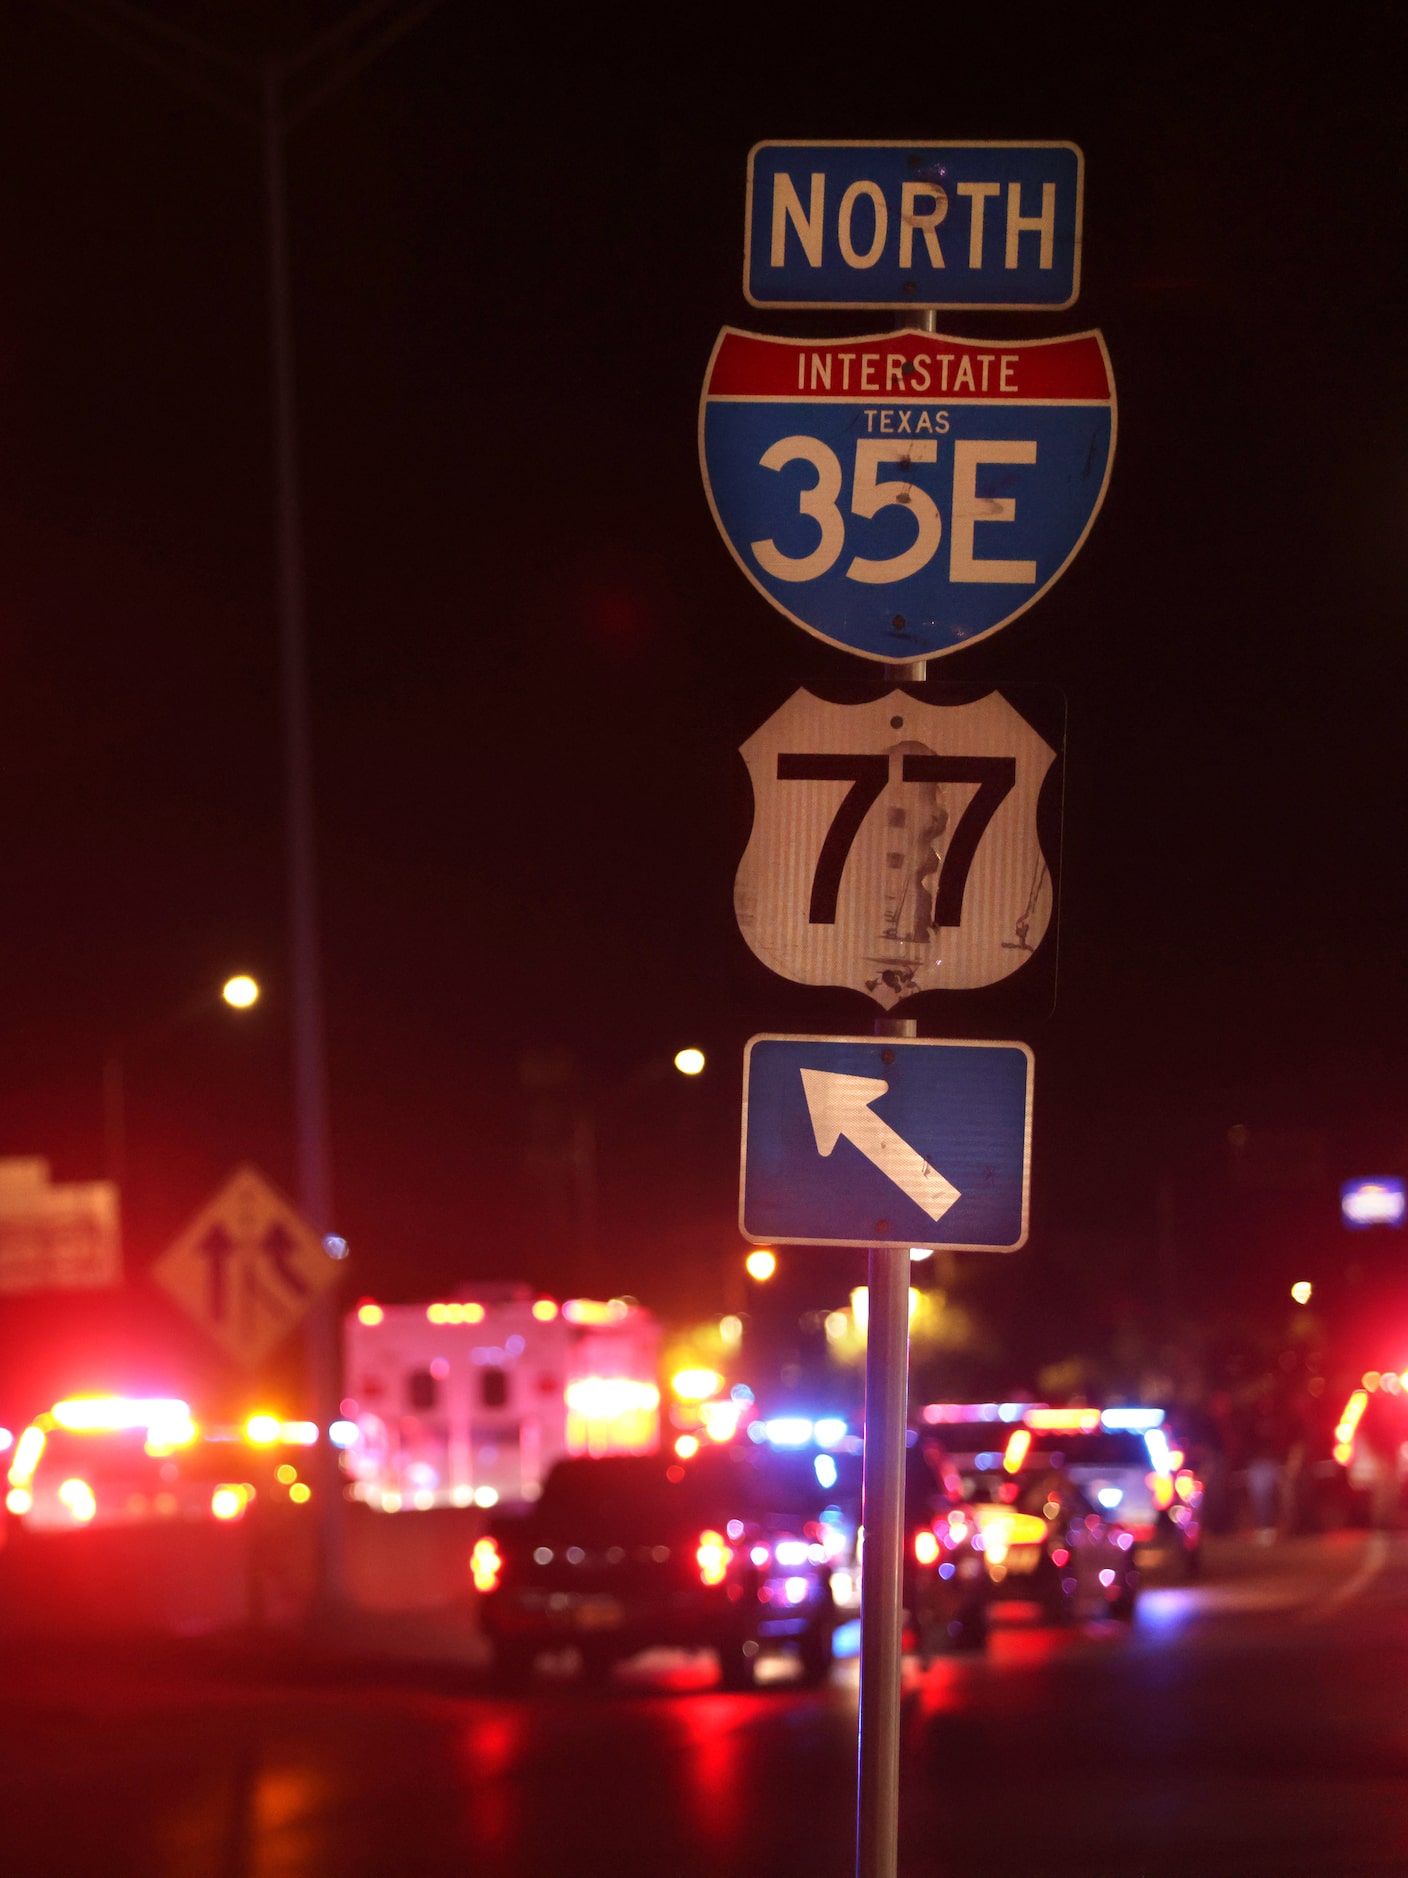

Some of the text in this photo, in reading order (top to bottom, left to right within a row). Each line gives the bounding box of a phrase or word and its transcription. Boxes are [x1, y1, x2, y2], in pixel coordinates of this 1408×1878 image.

[769, 172, 1057, 270] NORTH
[797, 353, 1020, 393] INTERSTATE
[864, 409, 951, 435] TEXAS
[750, 434, 1038, 585] 35E
[777, 752, 1016, 927] 77
